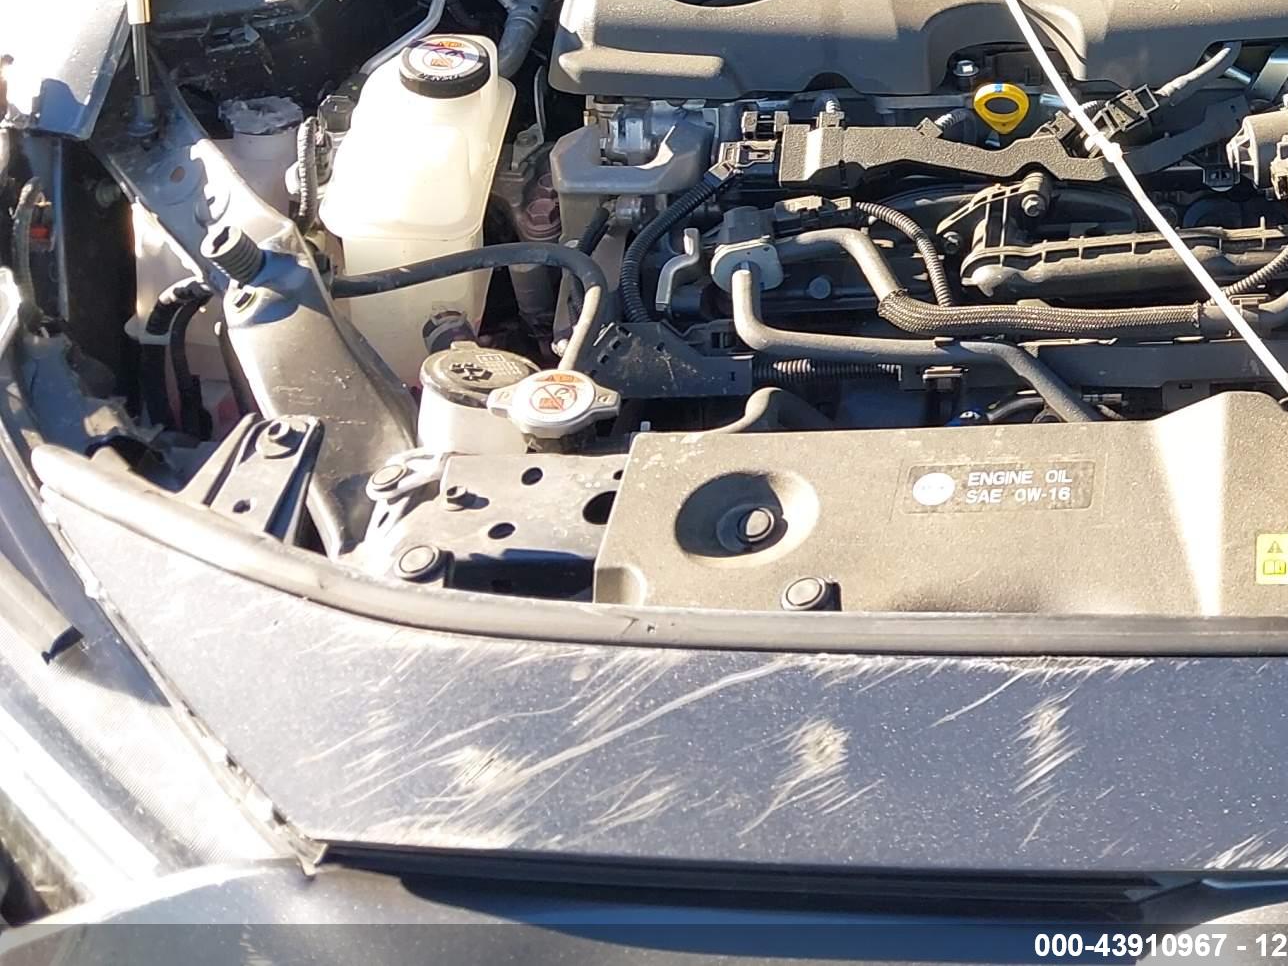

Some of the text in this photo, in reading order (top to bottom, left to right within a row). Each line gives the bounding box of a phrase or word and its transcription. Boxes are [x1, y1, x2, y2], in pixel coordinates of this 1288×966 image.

[967, 470, 1073, 486] ENGINE OIL
[965, 487, 1071, 504] SAE 0W-16
